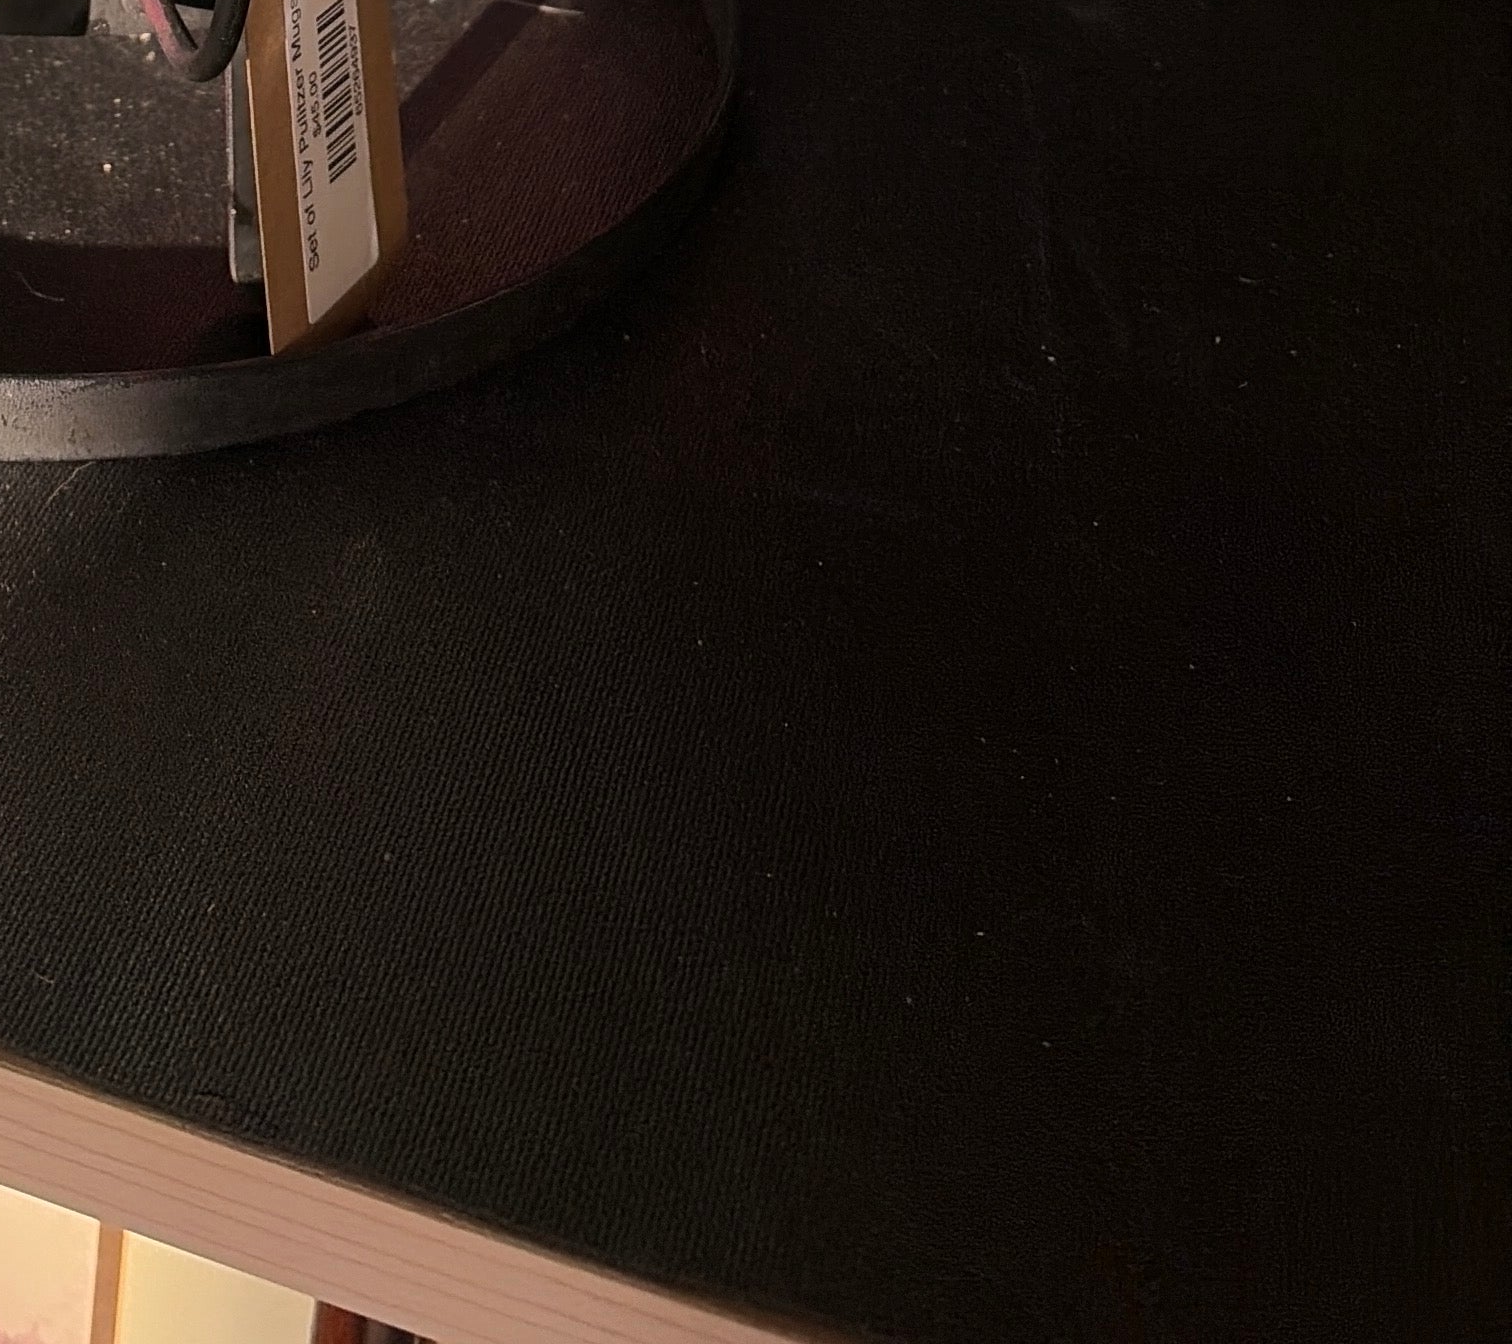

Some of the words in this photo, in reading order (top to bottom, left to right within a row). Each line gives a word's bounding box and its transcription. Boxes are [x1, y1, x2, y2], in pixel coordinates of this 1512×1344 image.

[294, 67, 310, 154] Pulitzer
[308, 70, 322, 139] $45.00
[301, 160, 313, 199] Lily
[304, 204, 316, 226] of
[308, 230, 320, 272] Set
